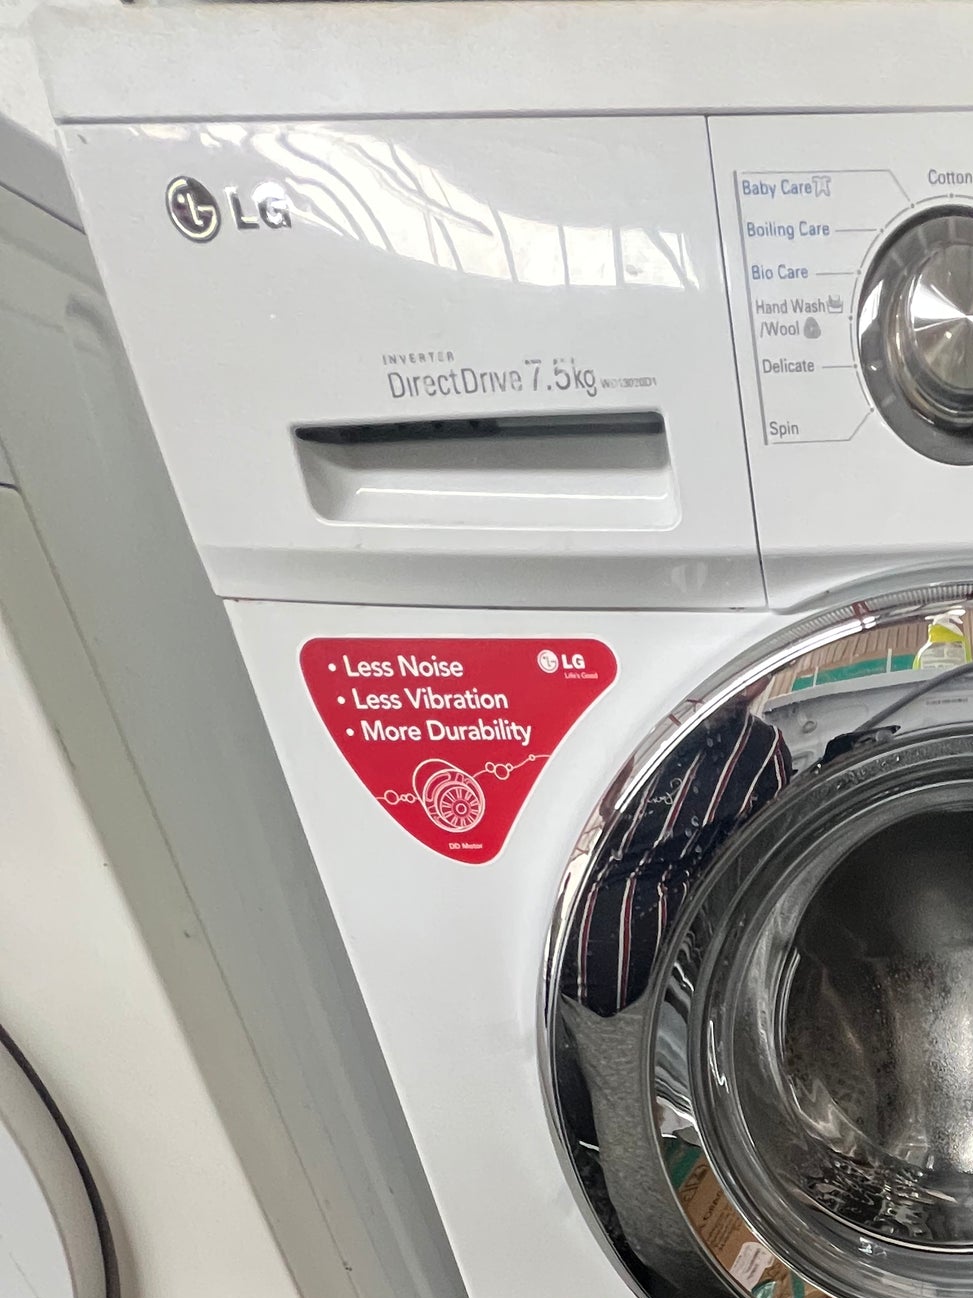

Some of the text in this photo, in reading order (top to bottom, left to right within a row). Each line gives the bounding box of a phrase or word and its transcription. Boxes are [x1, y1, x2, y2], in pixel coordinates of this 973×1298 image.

[928, 169, 973, 185] Cotton
[742, 180, 812, 198] Baby Care
[224, 184, 293, 231] LG
[746, 222, 830, 240] Boiling Care
[751, 265, 809, 280] Bio Care
[755, 299, 825, 315] Hand Wash
[760, 321, 800, 338] /Wool
[382, 351, 455, 366] INVERTER
[762, 359, 815, 374] Delicate
[524, 358, 598, 398] 7.5kg
[769, 421, 799, 438] Spin
[342, 655, 464, 677] Less Noise
[561, 654, 586, 669] LG
[351, 687, 509, 710] Less Vibration
[360, 718, 532, 746] More Durability
